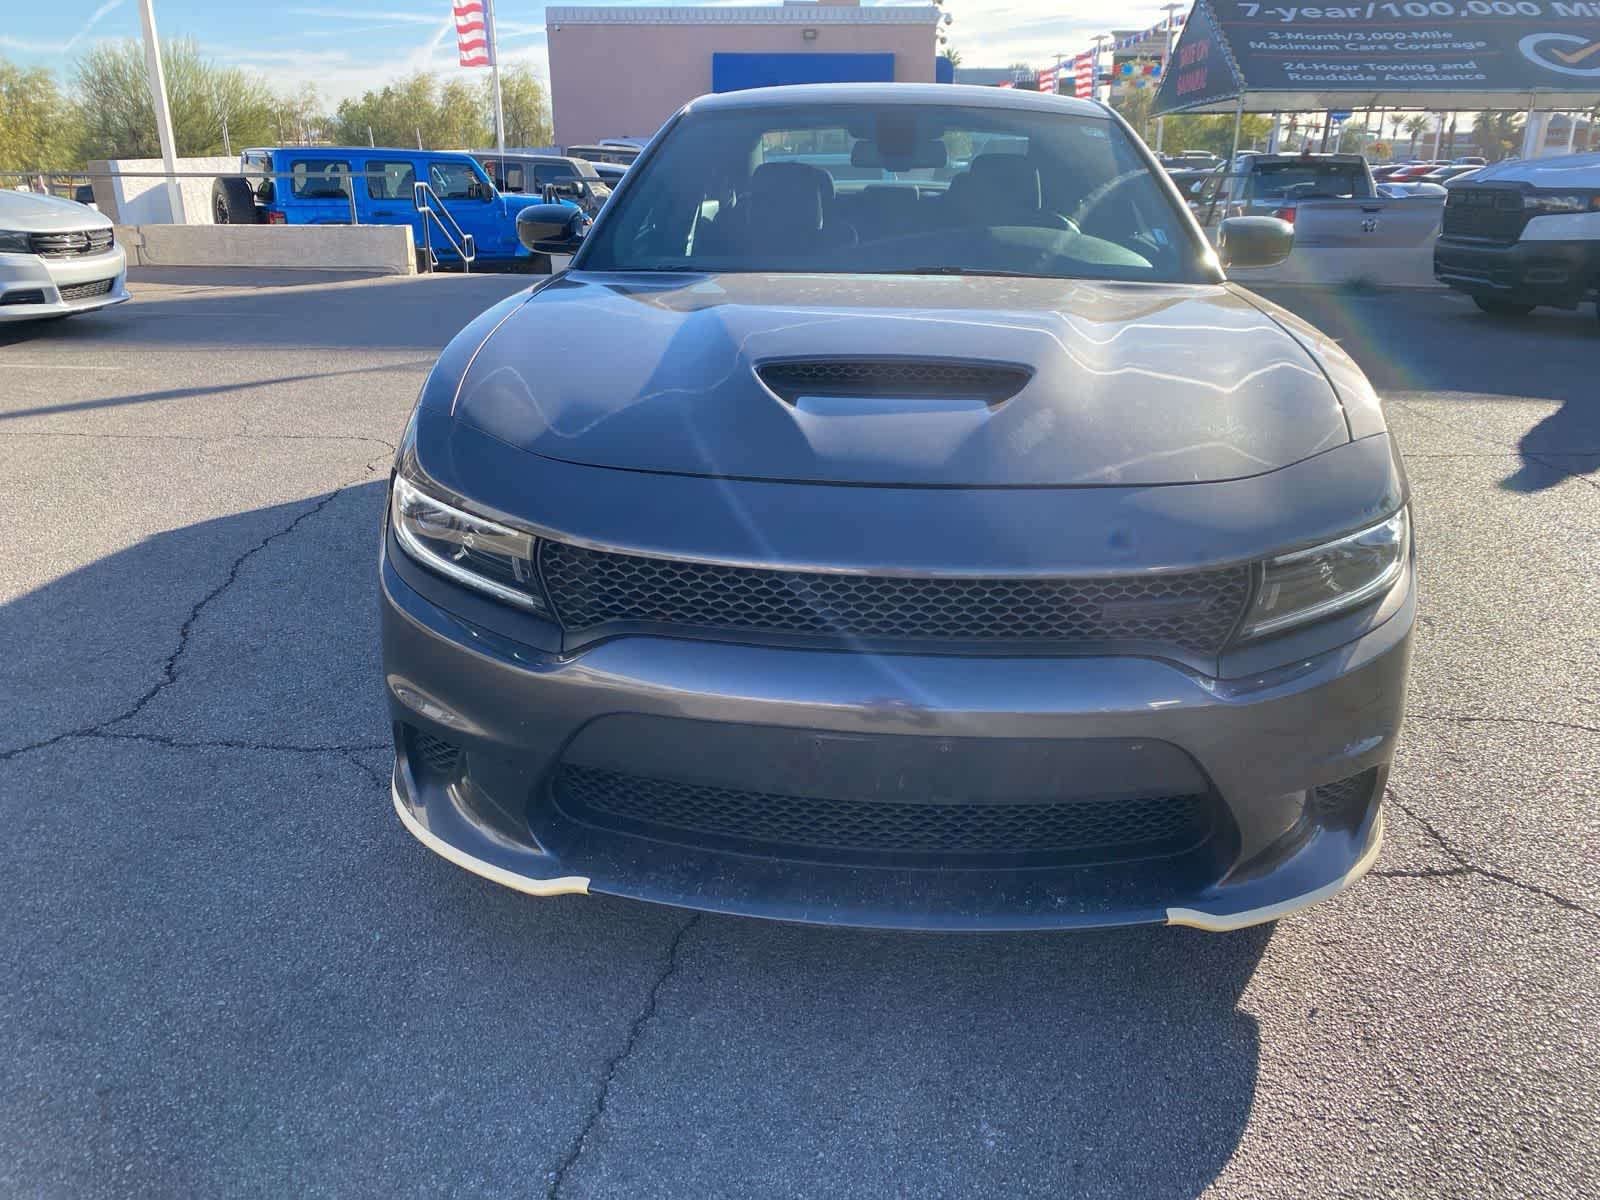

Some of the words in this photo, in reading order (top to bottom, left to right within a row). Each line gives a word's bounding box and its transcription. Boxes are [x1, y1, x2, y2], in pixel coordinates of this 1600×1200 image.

[1236, 1, 1543, 22] 7-year/100,000
[1552, 2, 1600, 17] Mi
[1267, 31, 1453, 41] 3-Month/3,000-Mile
[1248, 40, 1340, 50] Maximum
[1345, 41, 1390, 51] Care
[1393, 40, 1487, 50] Coverage
[1282, 62, 1360, 71] 24-Hour
[1368, 62, 1435, 72] Towing
[1441, 60, 1477, 70] and
[1287, 72, 1377, 81] Roadside
[1384, 72, 1487, 81] Assistance
